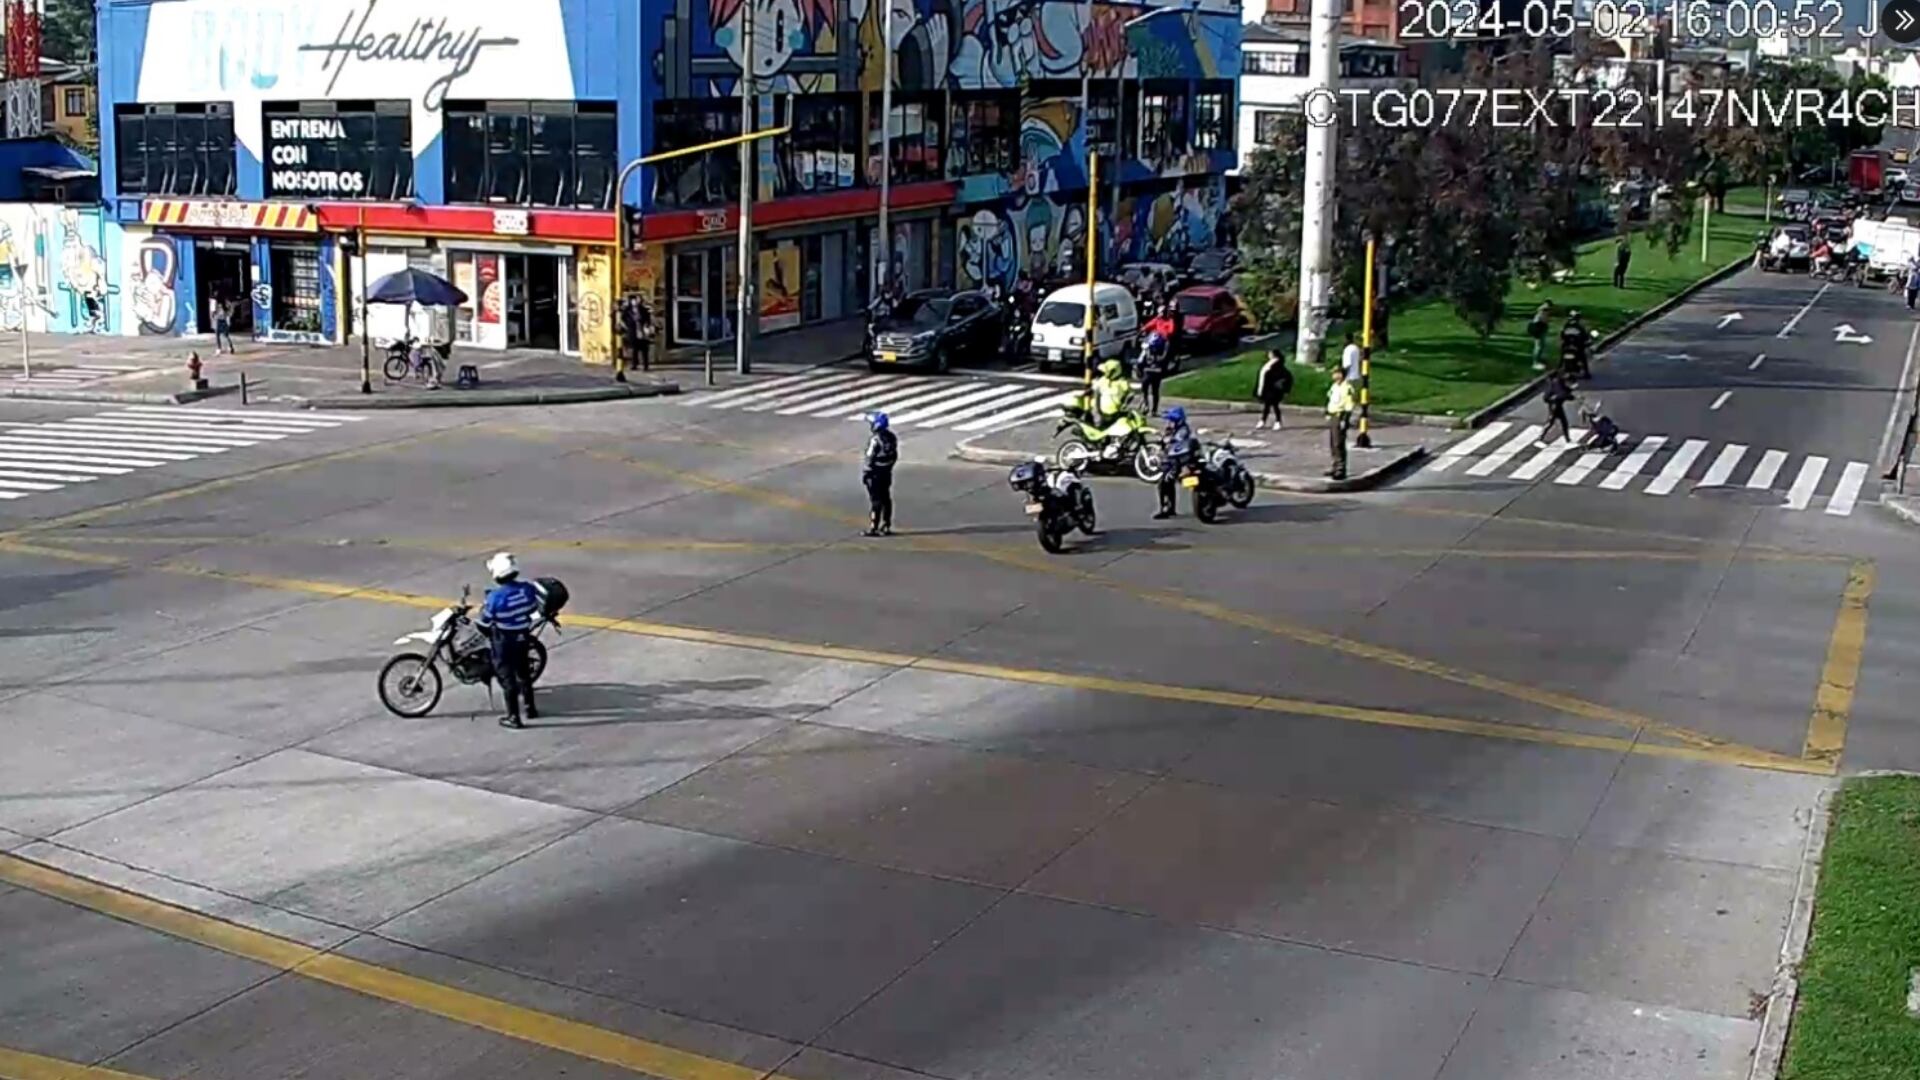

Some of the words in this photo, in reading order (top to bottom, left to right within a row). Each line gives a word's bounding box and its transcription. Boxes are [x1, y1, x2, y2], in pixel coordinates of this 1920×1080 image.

[298, 0, 519, 113] Healthy
[271, 119, 347, 139] ENTRENA
[271, 145, 307, 165] CON
[272, 171, 364, 191] NOSOTROS
